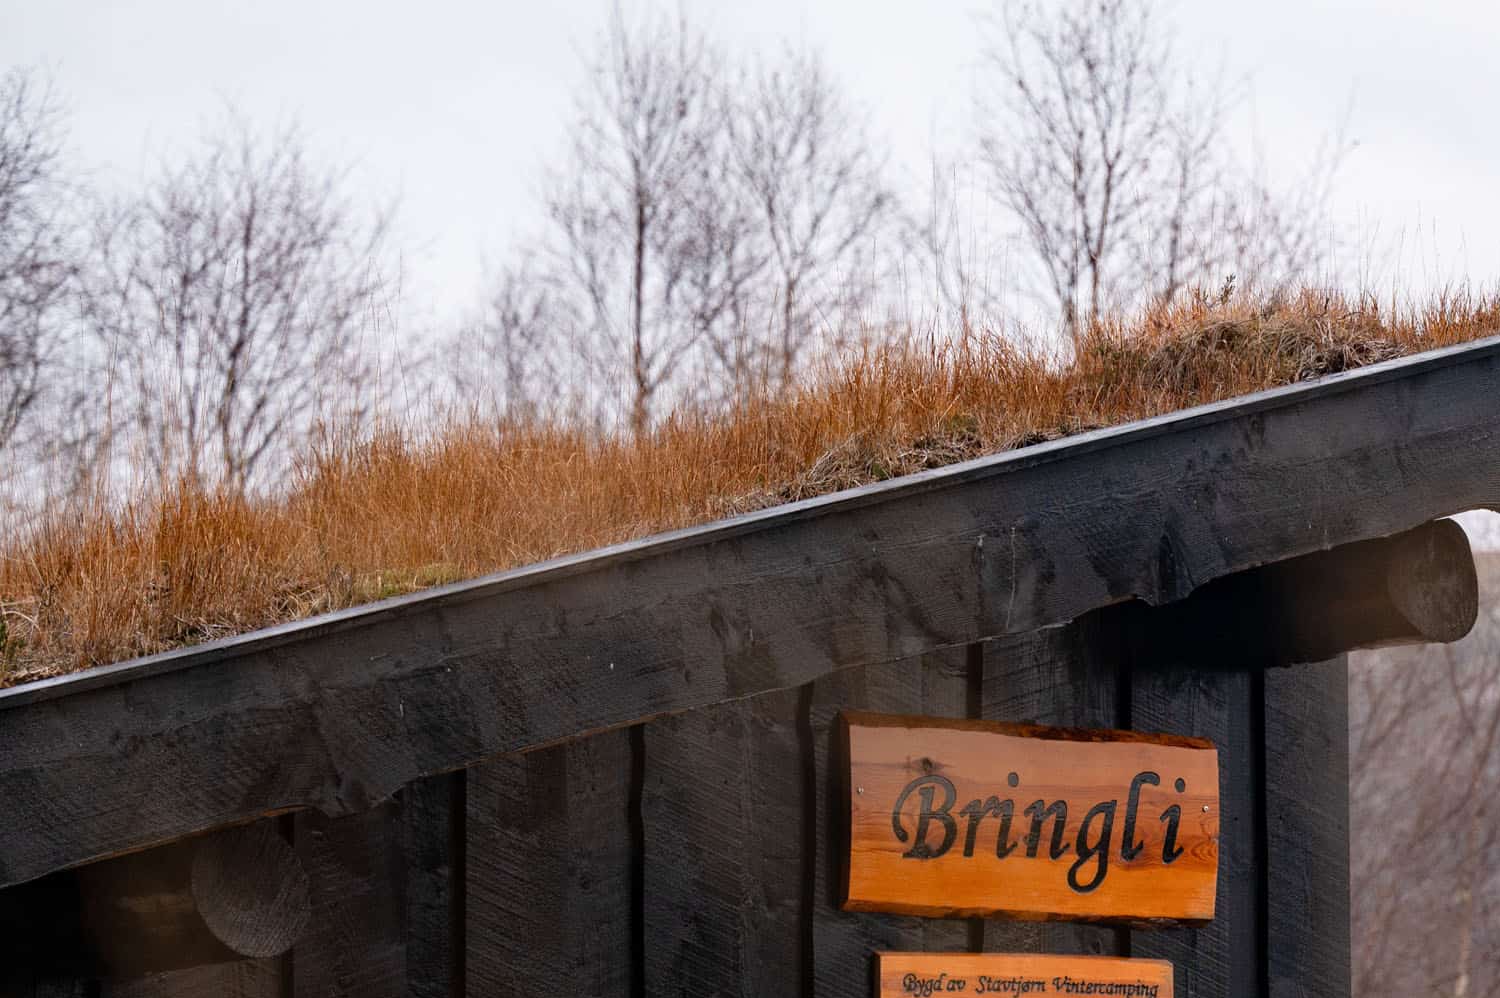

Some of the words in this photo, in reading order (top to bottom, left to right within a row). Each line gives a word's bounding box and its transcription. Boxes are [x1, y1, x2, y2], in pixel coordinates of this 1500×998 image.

[891, 771, 1185, 893] Bringli
[903, 973, 947, 998] Bygd
[946, 978, 966, 992] av
[975, 975, 1046, 998] Stavtjørn
